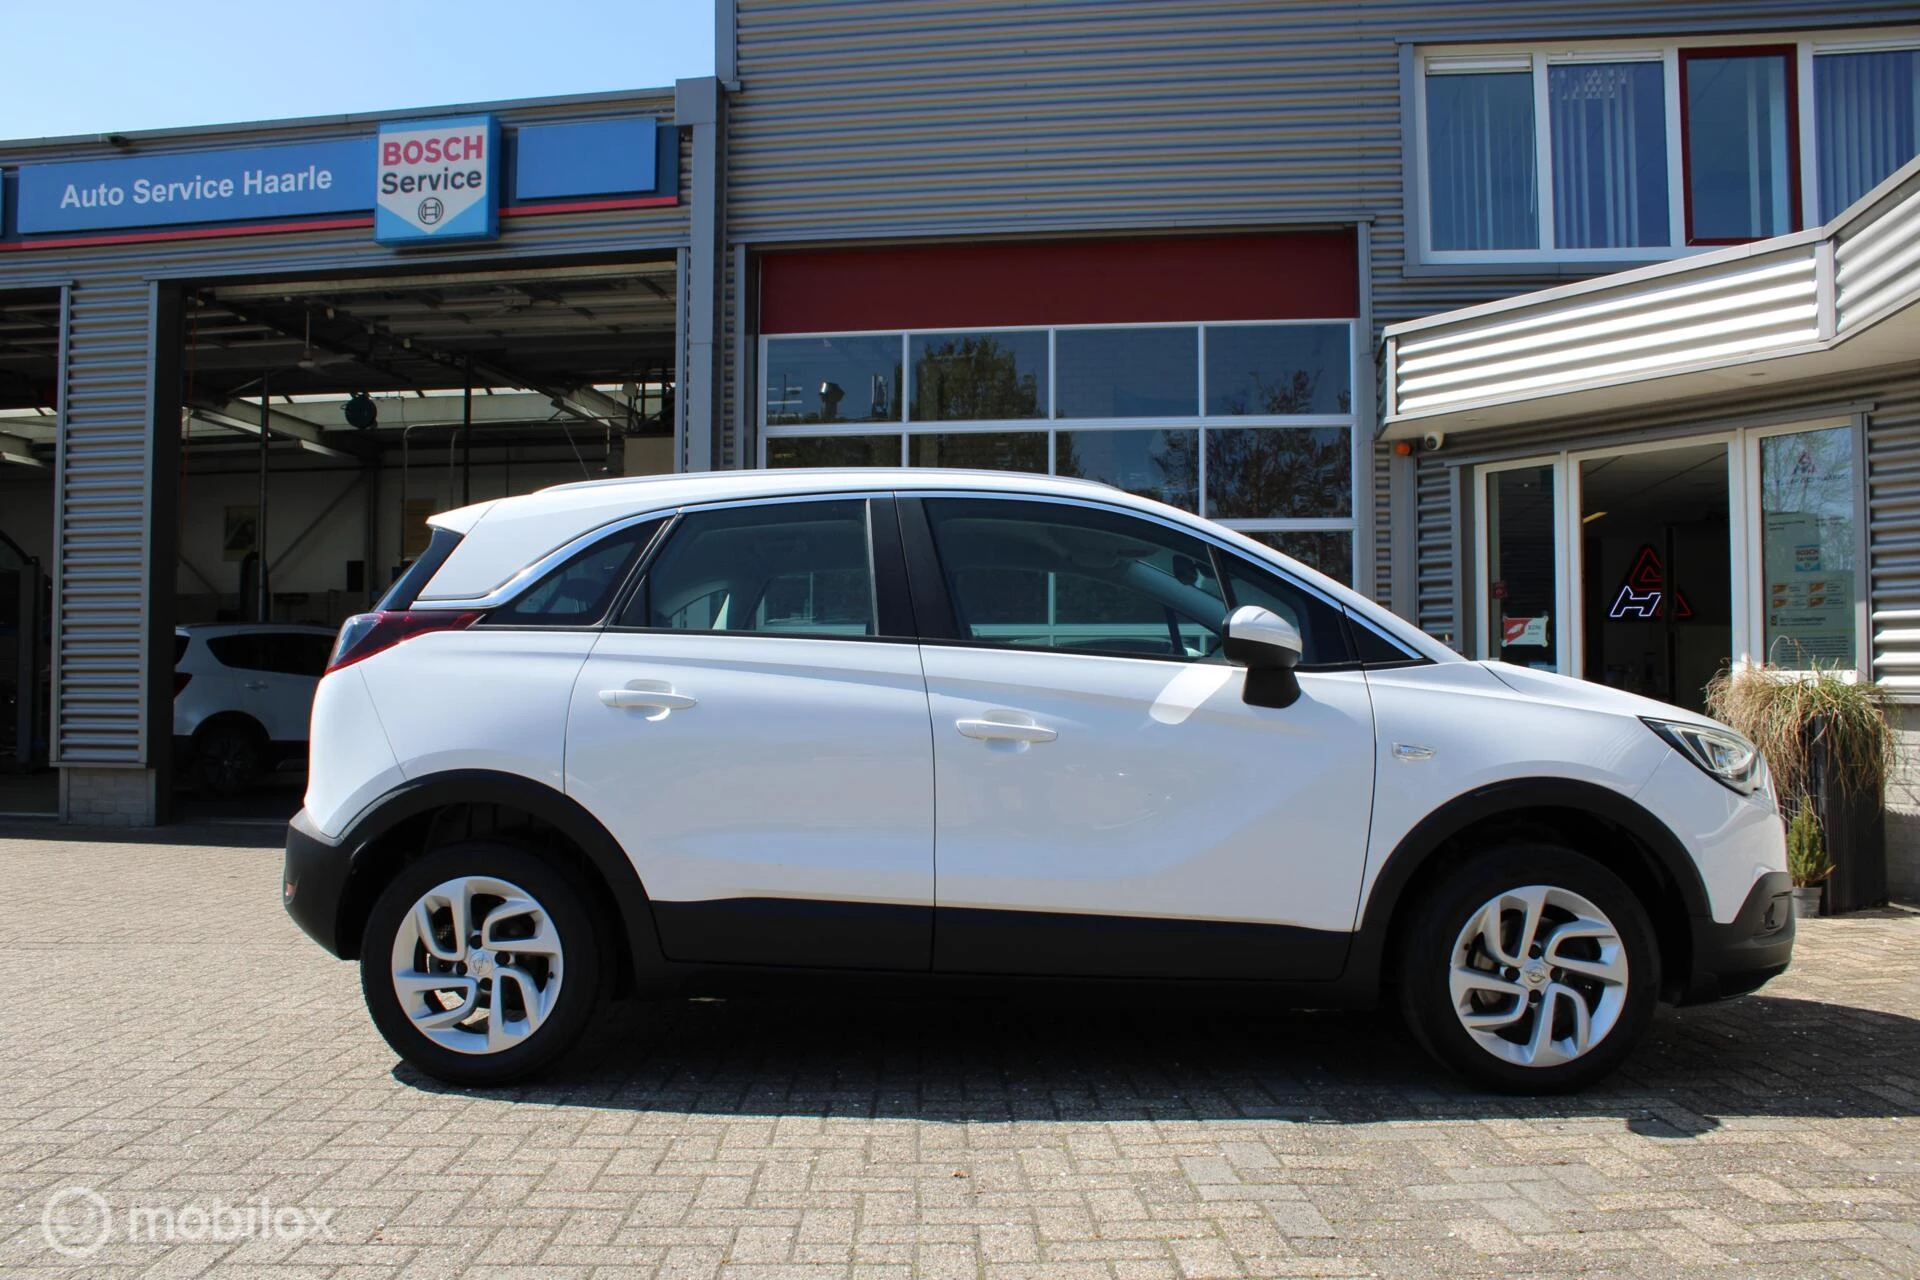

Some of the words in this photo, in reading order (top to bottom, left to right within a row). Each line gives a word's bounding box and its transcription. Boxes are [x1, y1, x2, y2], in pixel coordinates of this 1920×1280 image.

[383, 135, 483, 166] BOSCH
[60, 184, 125, 208] Auto
[133, 175, 234, 204] Service
[243, 165, 332, 195] Haarle
[381, 167, 482, 195] Service
